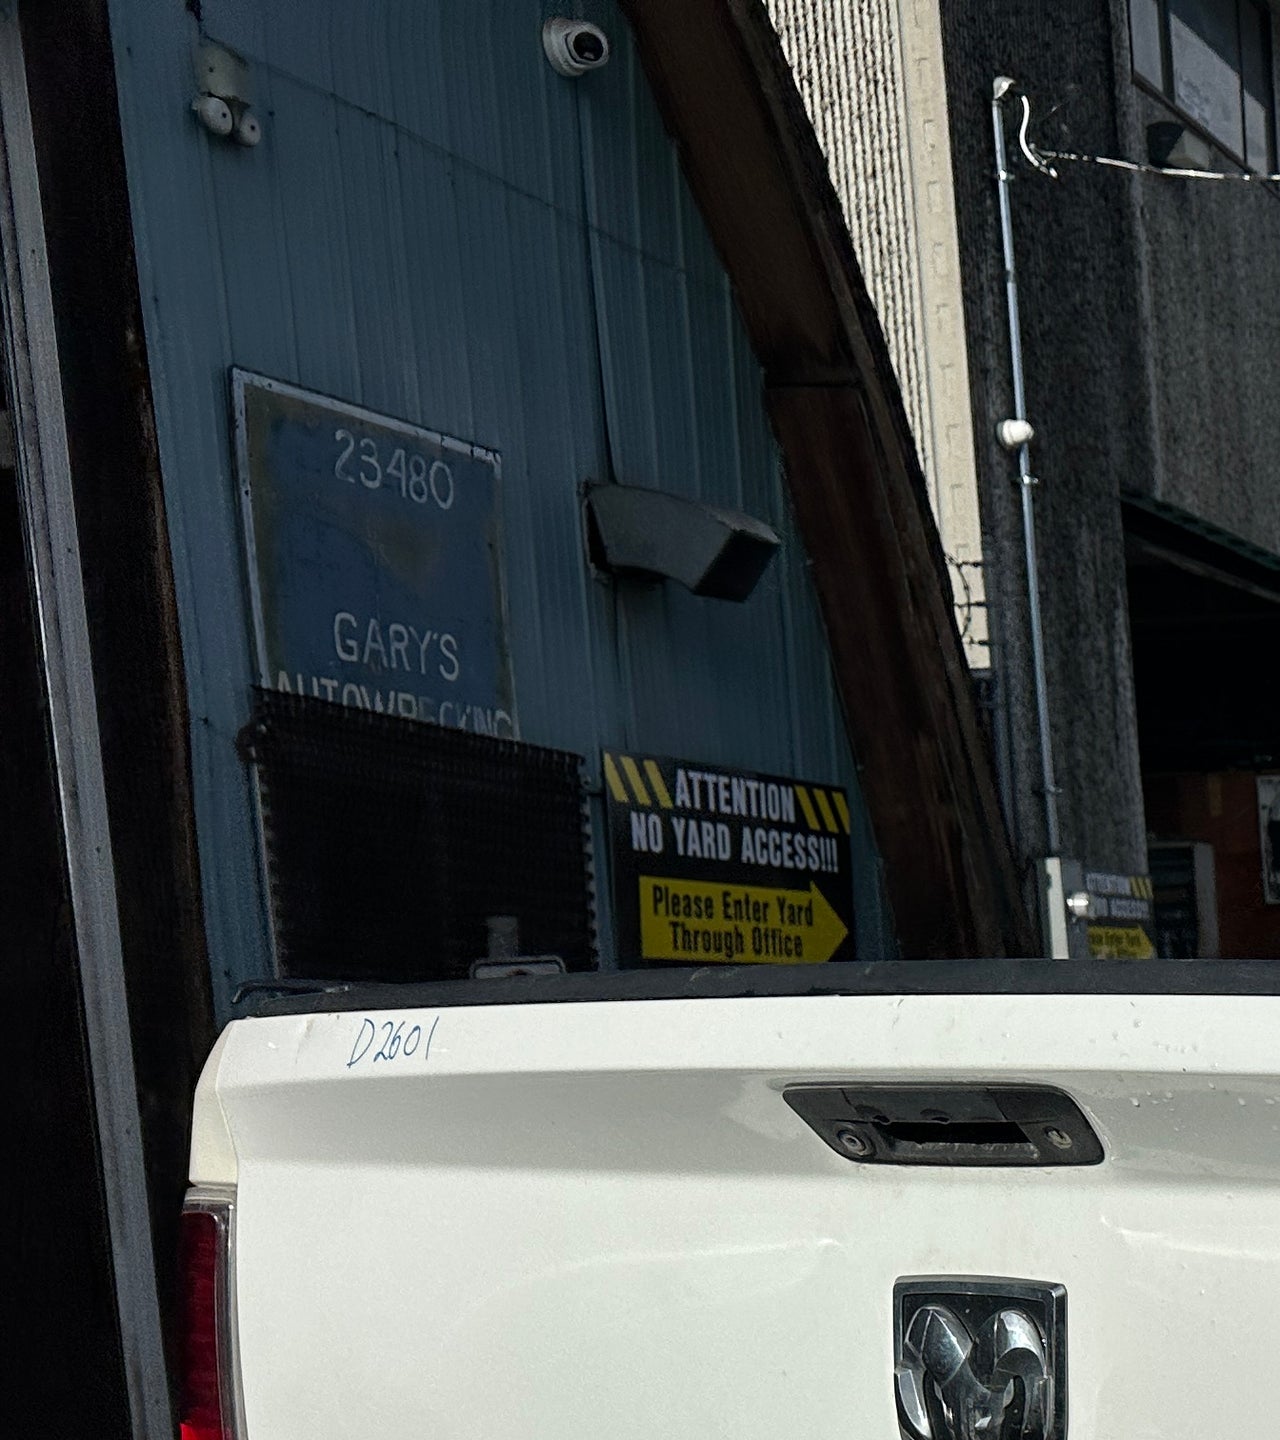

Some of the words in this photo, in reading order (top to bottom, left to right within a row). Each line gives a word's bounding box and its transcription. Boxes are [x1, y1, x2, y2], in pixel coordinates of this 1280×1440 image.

[334, 428, 454, 510] 23480
[333, 611, 460, 682] GARY'S
[674, 767, 797, 824] ATTENTION
[629, 810, 664, 854] NO
[670, 816, 732, 863] YARD
[740, 825, 840, 874] ACCESS!!!
[652, 884, 715, 919] Please
[722, 890, 769, 925] Enter
[776, 896, 814, 927] Yard
[668, 920, 745, 959] Through
[752, 925, 804, 958] Office
[346, 1015, 440, 1069] D2601
